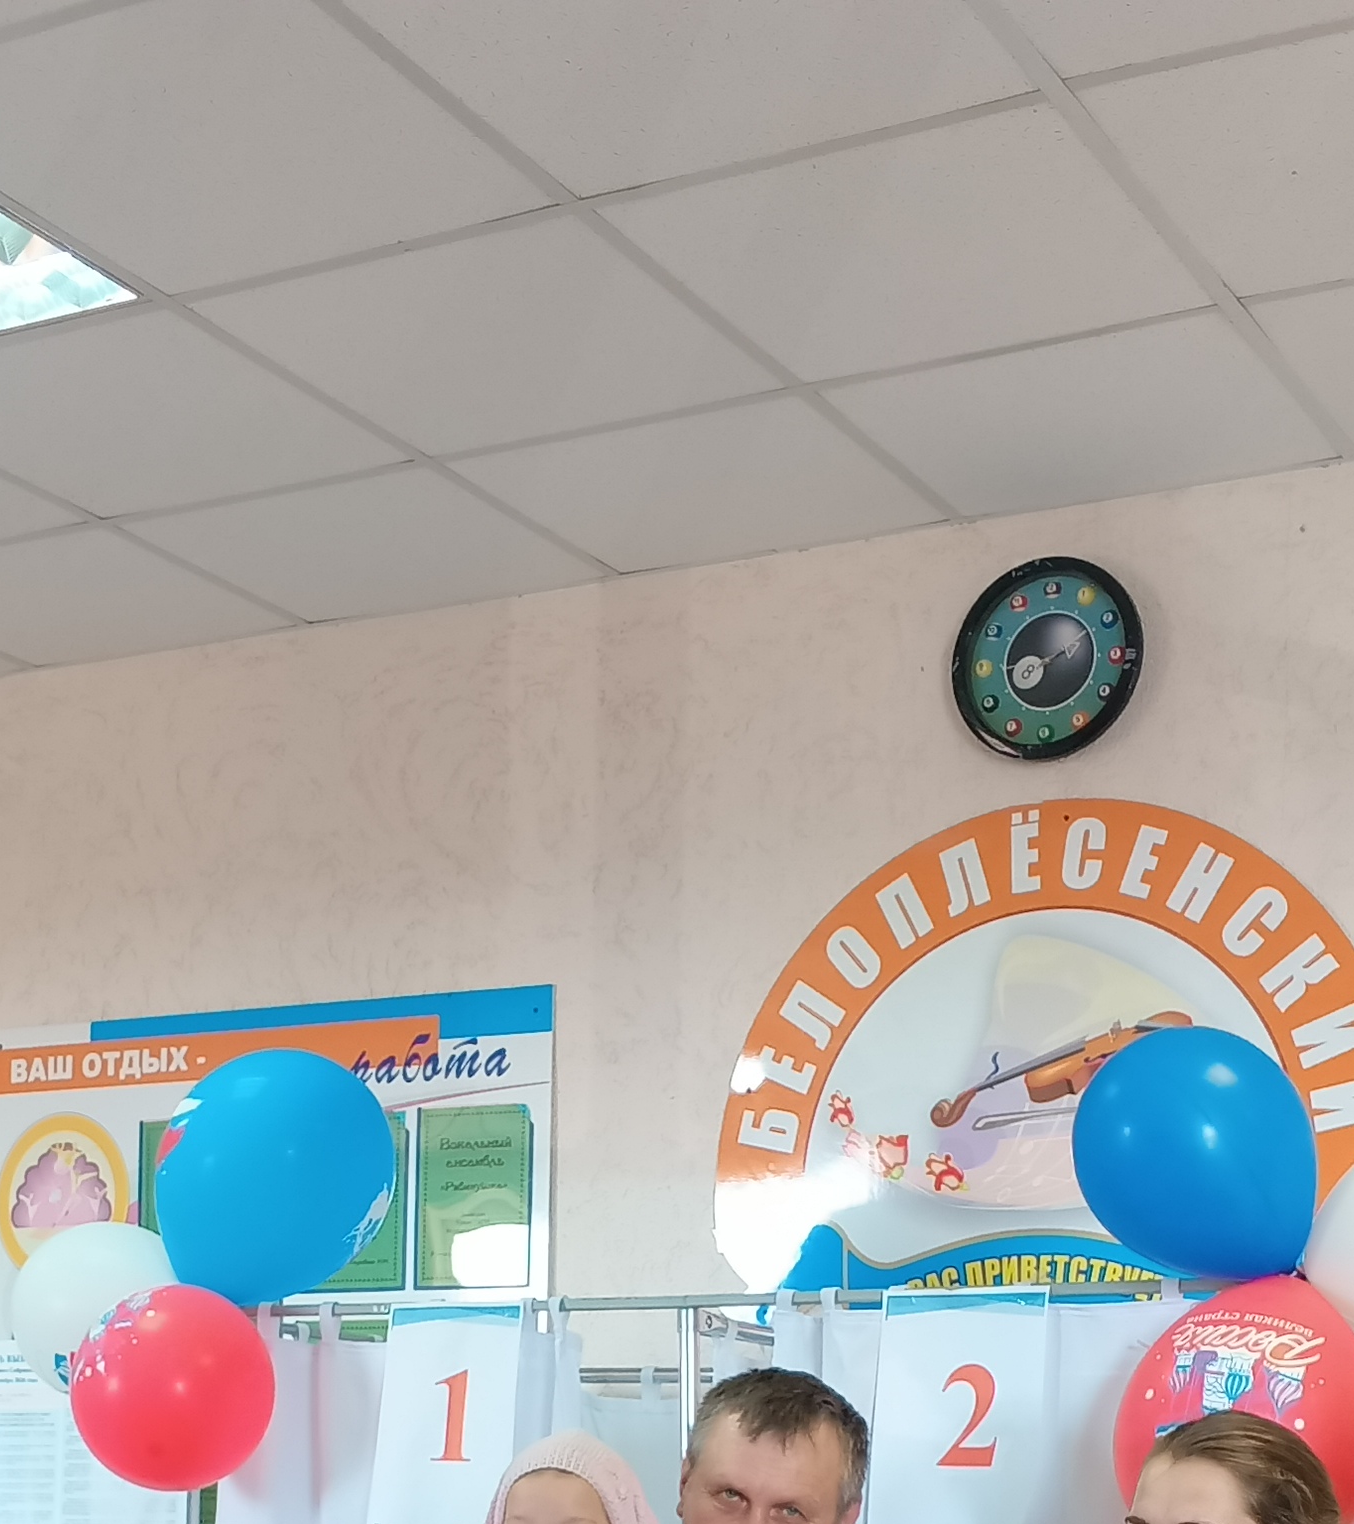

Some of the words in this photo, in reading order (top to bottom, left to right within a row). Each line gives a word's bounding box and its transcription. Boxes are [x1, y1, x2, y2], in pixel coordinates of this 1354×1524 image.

[1021, 664, 1035, 680] 8
[10, 1054, 73, 1085] ВАШ
[82, 1046, 188, 1078] ОТДЫХ
[1186, 1310, 1242, 1324] страна
[430, 1368, 471, 1463] 1
[935, 1363, 999, 1468] 2
